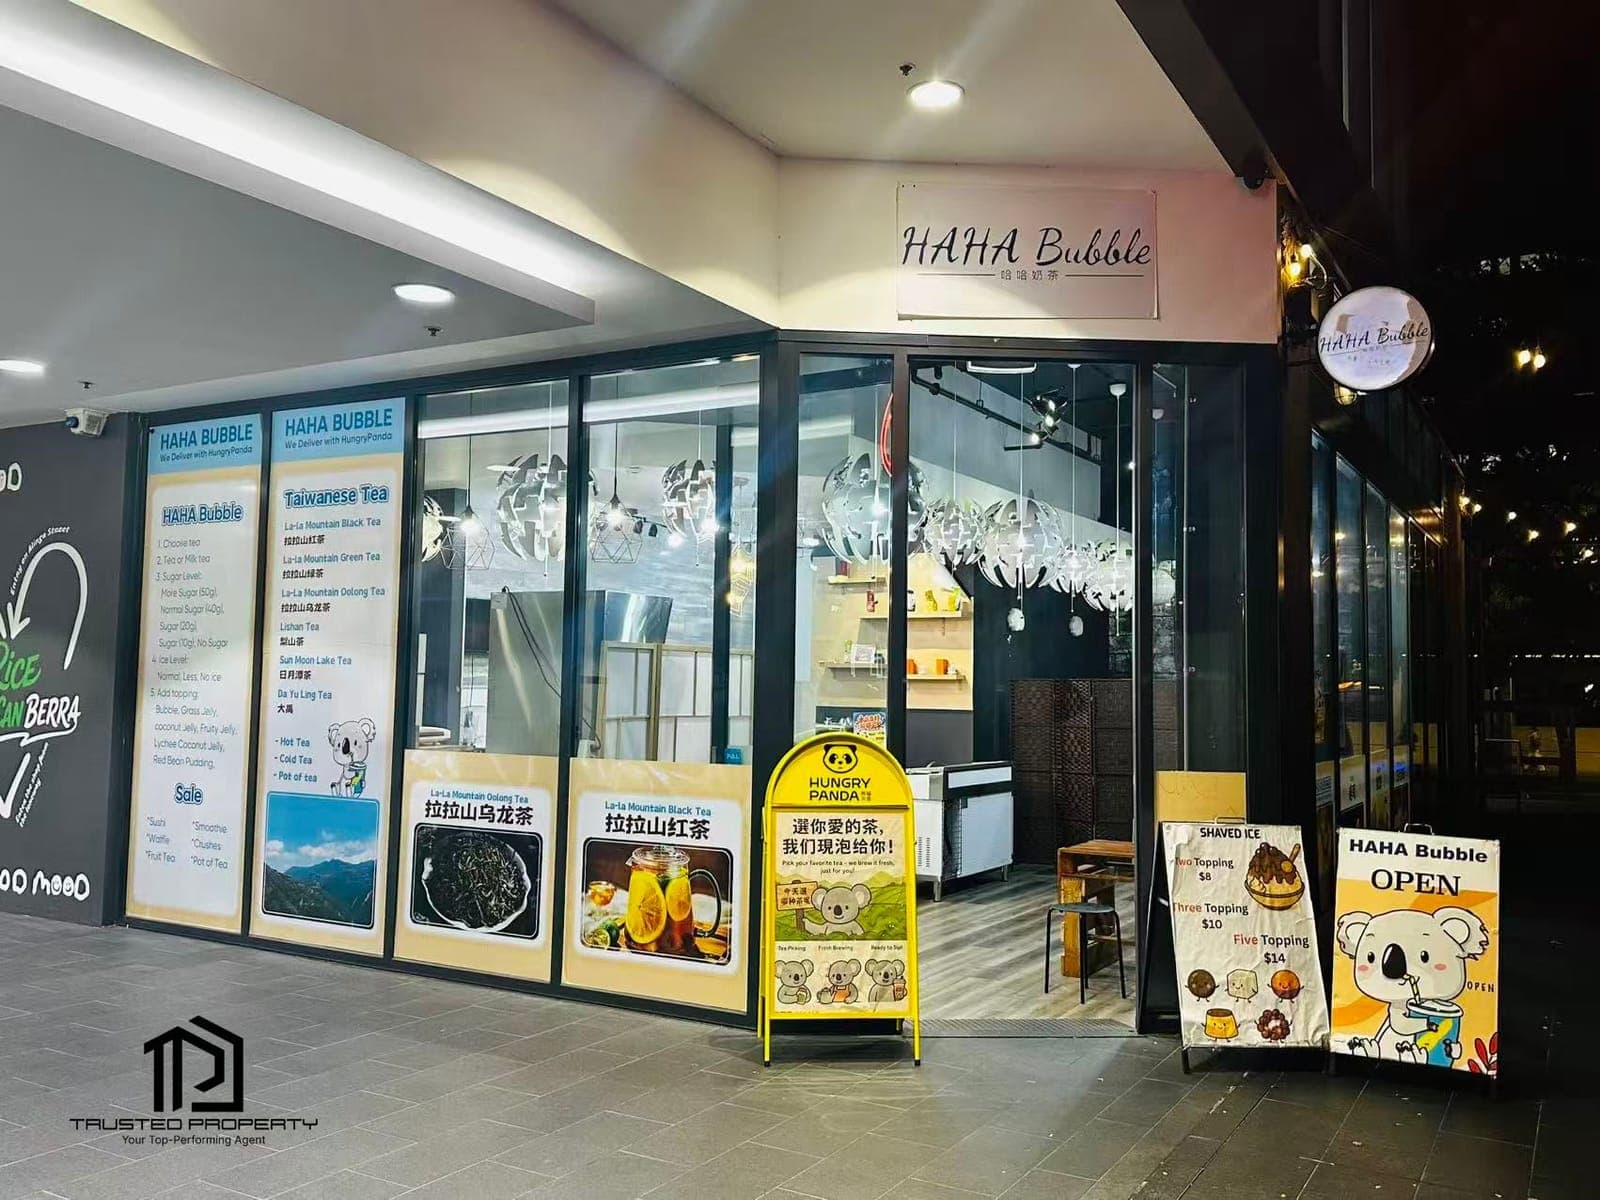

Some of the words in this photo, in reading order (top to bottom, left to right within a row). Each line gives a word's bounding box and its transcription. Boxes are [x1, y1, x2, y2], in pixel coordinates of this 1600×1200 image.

[901, 226, 1021, 266] HAHA
[1035, 226, 1152, 266] Bubble
[1000, 269, 1060, 282] 哈哈奶茶
[1319, 330, 1371, 353] HAHA
[1376, 320, 1429, 345] Bubble
[286, 416, 328, 437] HAHA
[333, 408, 392, 431] BUBBLE
[161, 430, 197, 450] HAHA
[201, 424, 253, 445] BUBBLE
[285, 441, 297, 449] We
[298, 439, 322, 448] Deliver
[324, 437, 340, 445] with
[342, 432, 392, 444] HungryPanda
[171, 452, 193, 461] Deliver
[194, 451, 207, 459] with
[209, 446, 253, 457] HungryPanda
[284, 489, 357, 508] Taiwanese
[360, 483, 389, 503] Tea
[162, 506, 196, 525] HAHA
[199, 502, 243, 523] Bubble
[305, 520, 339, 529] Mountain
[341, 518, 364, 527] Black
[366, 518, 381, 526] Tea
[164, 555, 175, 564] Tea
[185, 555, 197, 563] Milk
[199, 555, 210, 563] tea
[304, 554, 338, 563] Mountain
[340, 553, 363, 561] Green
[366, 552, 380, 561] Tea
[163, 572, 182, 582] Sugar
[161, 589, 177, 598] More
[179, 588, 198, 599] Sugar
[304, 587, 338, 597] Mountain
[340, 587, 368, 598] Oolong
[370, 587, 385, 596] Tea
[161, 606, 183, 614] Normal
[184, 605, 204, 615] Sugar
[160, 622, 179, 632] Sugar
[280, 622, 303, 631] Lishan
[306, 622, 319, 631] Tea
[159, 638, 178, 649] Sugar
[197, 639, 207, 648] No
[208, 638, 228, 649] Sugar
[279, 655, 293, 664] Sun
[295, 656, 314, 664] Moon
[317, 656, 335, 665] Lake
[337, 656, 352, 665] Tea
[200, 673, 210, 681] No
[157, 688, 170, 697] Add
[277, 689, 287, 698] Da
[290, 690, 299, 698] Yu
[300, 690, 316, 701] Ling
[318, 691, 332, 699] Tea
[181, 705, 200, 715] Grass
[154, 738, 177, 748] Lychee
[178, 739, 207, 750] Coconut
[280, 737, 294, 746] Hot
[296, 738, 310, 747] Tea
[153, 755, 166, 764] Red
[167, 756, 184, 765] Bean
[279, 754, 296, 764] Cold
[299, 756, 312, 764] Tea
[278, 771, 291, 781] Pot
[294, 772, 302, 781] of
[305, 773, 317, 782] tea
[810, 778, 871, 789] HUNGRY
[175, 783, 203, 805] Sale
[431, 789, 450, 798] La-La
[452, 791, 485, 800] Mountain
[487, 793, 512, 804] Oolong
[515, 795, 528, 804] Tea
[810, 791, 860, 801] PANDA
[425, 800, 534, 826] 拉拉山乌龙茶
[628, 803, 667, 814] Mountain
[668, 805, 692, 815] Black
[695, 806, 712, 817] Tea
[605, 813, 711, 840] 拉拉山红茶
[1200, 827, 1242, 839] SHAVED
[1245, 828, 1261, 839] ICE
[1349, 838, 1408, 857] HAHA
[1415, 844, 1488, 863] Bubble
[163, 852, 176, 863] Tea
[1194, 857, 1234, 869] Topping
[215, 858, 228, 869] Tea
[1198, 871, 1212, 881] $8
[1371, 868, 1461, 897] OPEN
[1204, 903, 1249, 915] Topping
[1202, 919, 1223, 929] $10
[1233, 934, 1258, 945] Five
[1260, 934, 1310, 948] Topping
[1263, 952, 1286, 964] $14
[1466, 981, 1495, 993] OPEN
